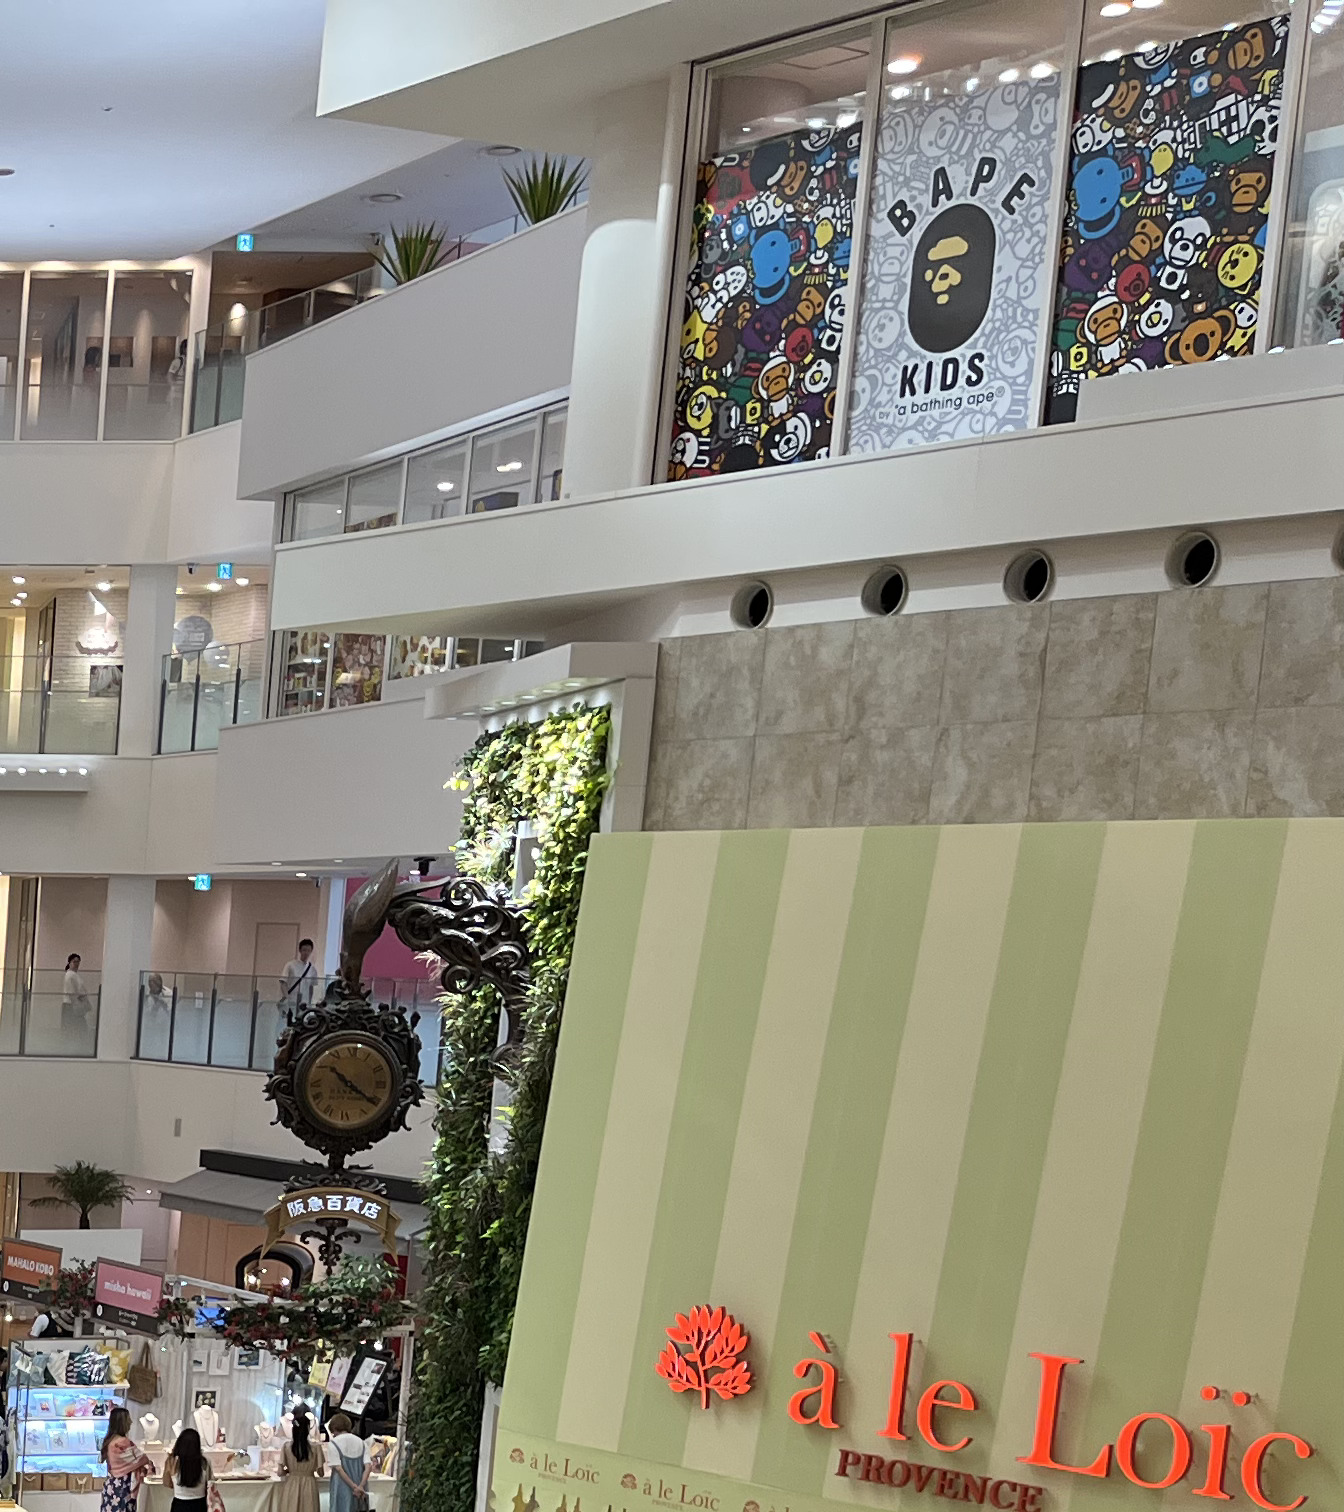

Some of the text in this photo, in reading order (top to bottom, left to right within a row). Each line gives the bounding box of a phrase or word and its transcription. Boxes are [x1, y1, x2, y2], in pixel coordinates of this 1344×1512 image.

[887, 156, 1035, 238] BAPE
[899, 352, 985, 398] KIDS
[911, 396, 962, 415] bathing
[286, 1194, 382, 1220] 阪急百貨店
[7, 1255, 55, 1276] MAHALO KOBO
[103, 1279, 126, 1294] misha
[787, 1330, 1314, 1512] à le Loïc
[543, 1453, 558, 1474] le
[563, 1457, 601, 1485] Loïc
[658, 1478, 674, 1501] le
[680, 1483, 722, 1512] Loïc
